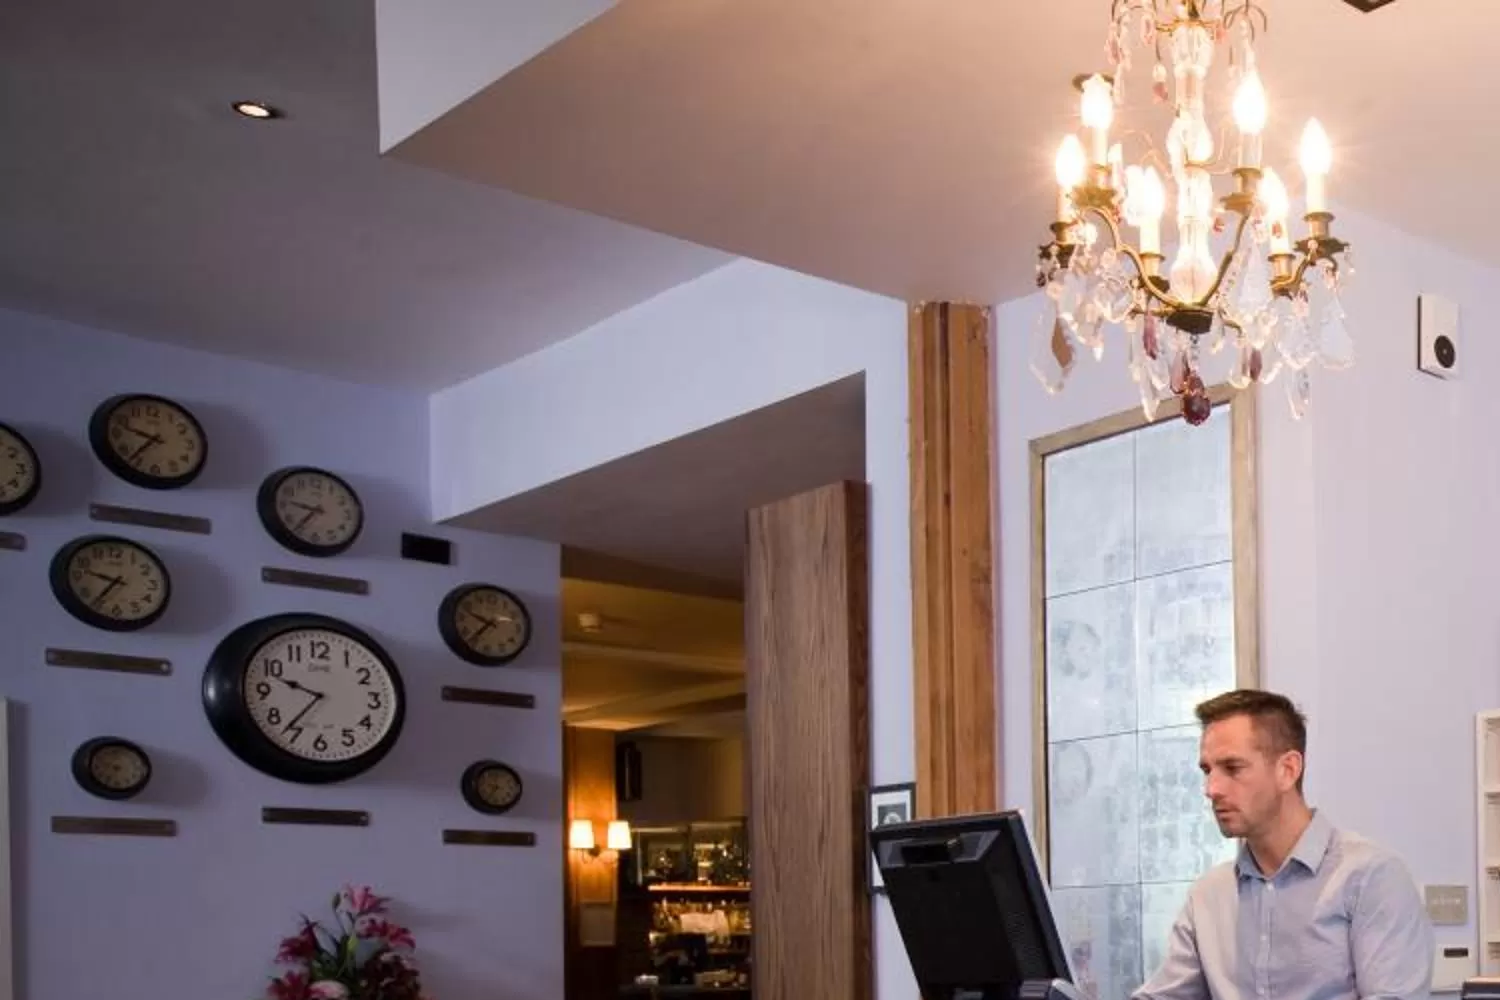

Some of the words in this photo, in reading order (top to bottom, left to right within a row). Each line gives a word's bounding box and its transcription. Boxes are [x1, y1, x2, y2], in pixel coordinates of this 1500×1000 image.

[288, 644, 301, 662] 11
[309, 640, 330, 660] 12
[344, 650, 350, 668] 1
[264, 658, 283, 677] 10
[356, 668, 371, 685] 2
[256, 682, 271, 700] 9
[367, 692, 381, 709] 3
[267, 707, 281, 725] 8
[358, 714, 372, 730] 4
[289, 726, 304, 744] 7
[313, 734, 328, 752] 6
[341, 729, 355, 747] 5
